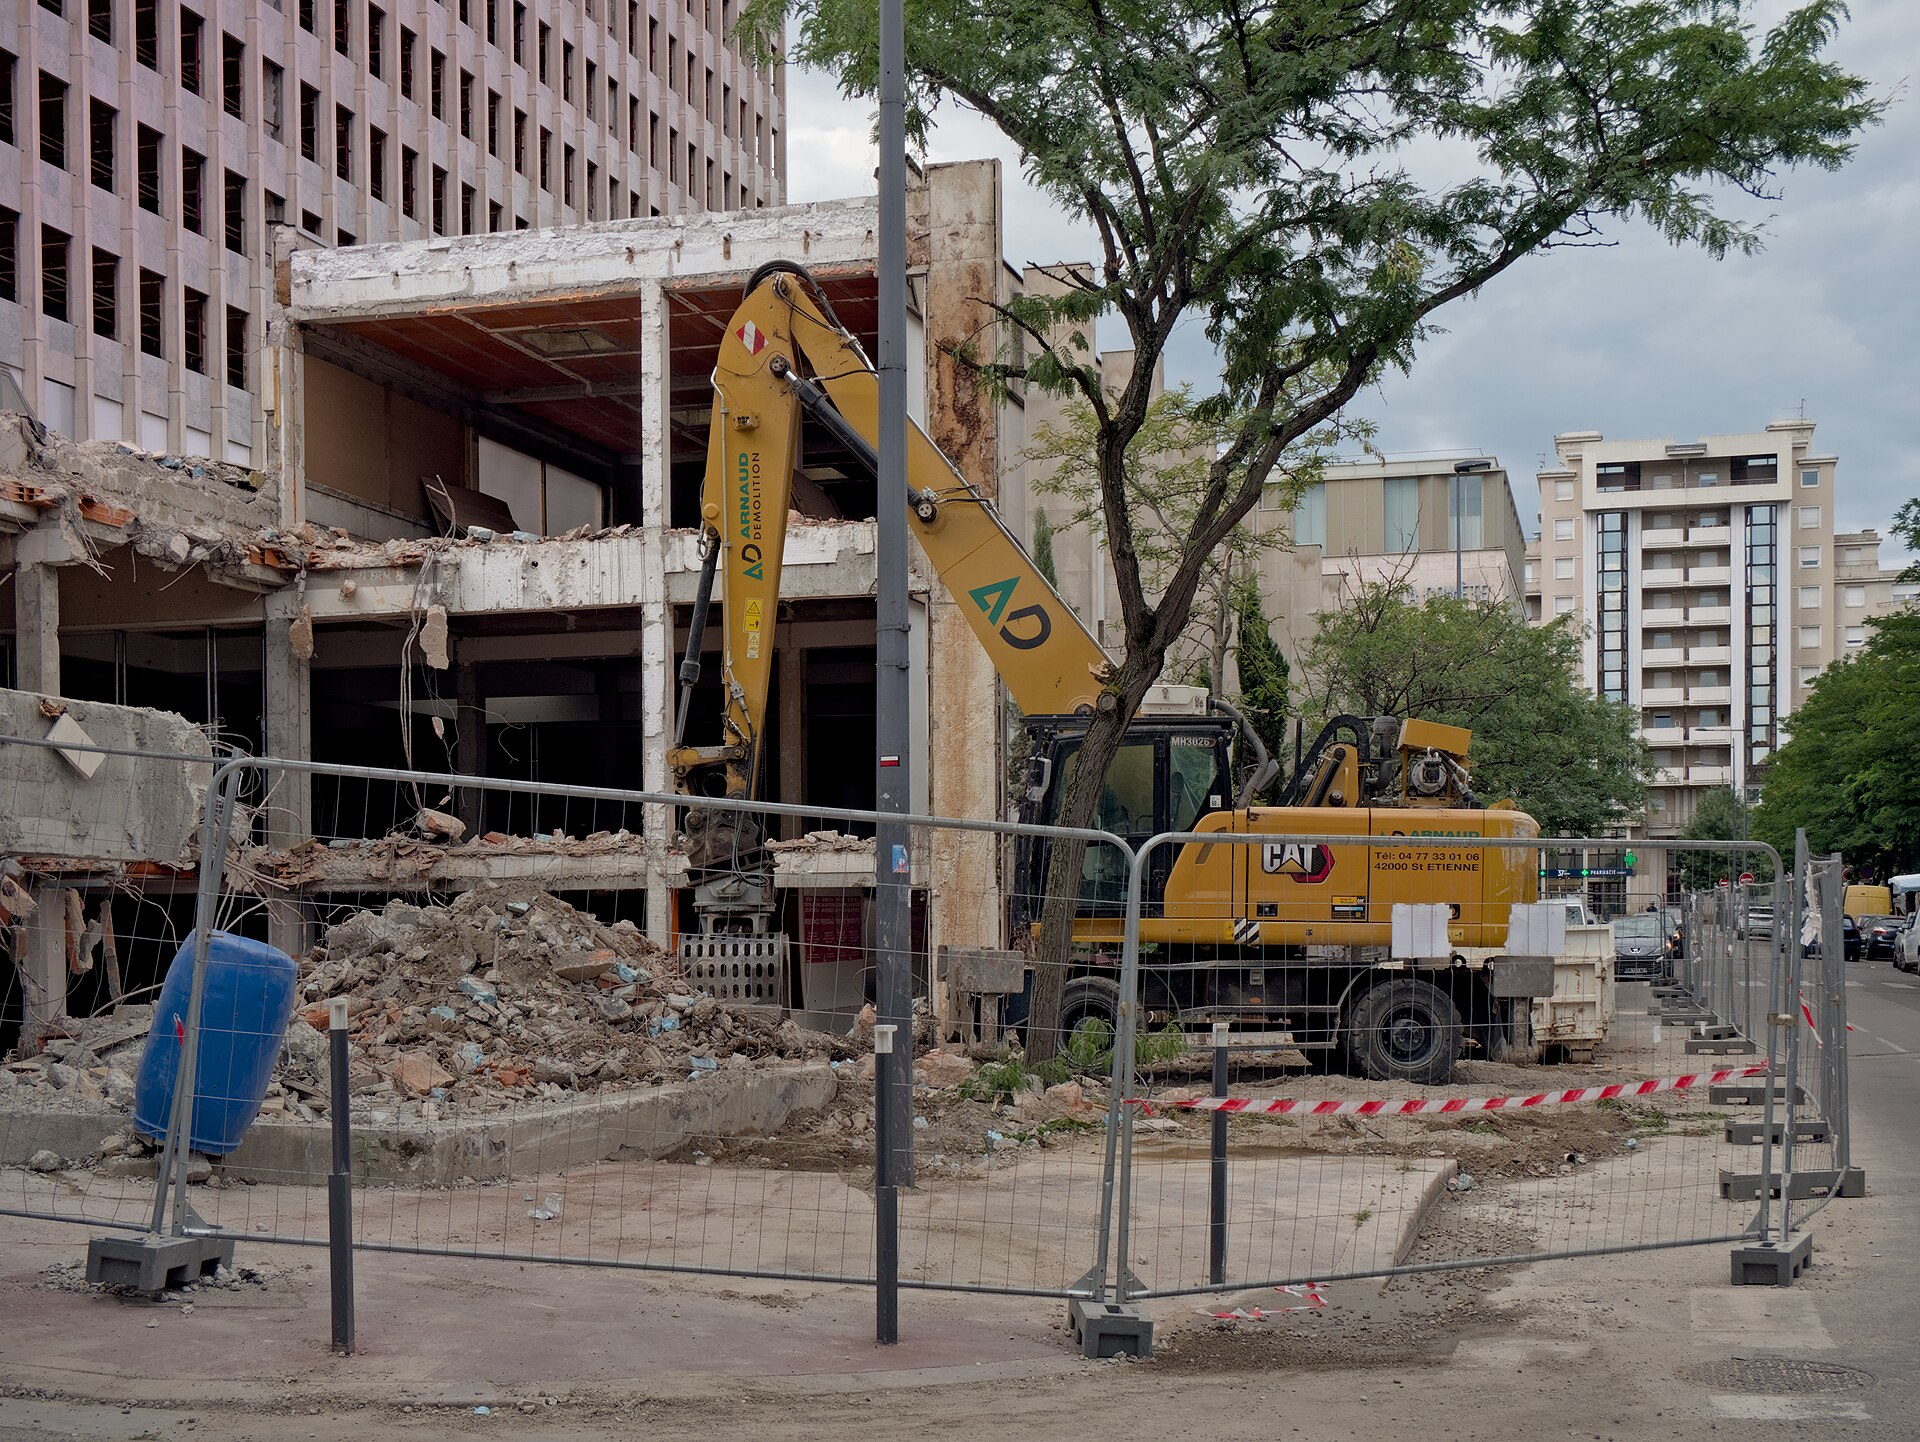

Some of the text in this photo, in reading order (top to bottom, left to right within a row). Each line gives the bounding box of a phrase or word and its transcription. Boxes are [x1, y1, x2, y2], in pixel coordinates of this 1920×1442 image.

[739, 452, 750, 539] ARNAUD
[752, 452, 761, 540] DEMOLITION
[1171, 736, 1210, 747] MH3026
[1262, 843, 1318, 873] CAT
[1374, 851, 1480, 861] Tél: 04 77 33 01 06
[1374, 862, 1480, 872] 42000 St ETIENNE
